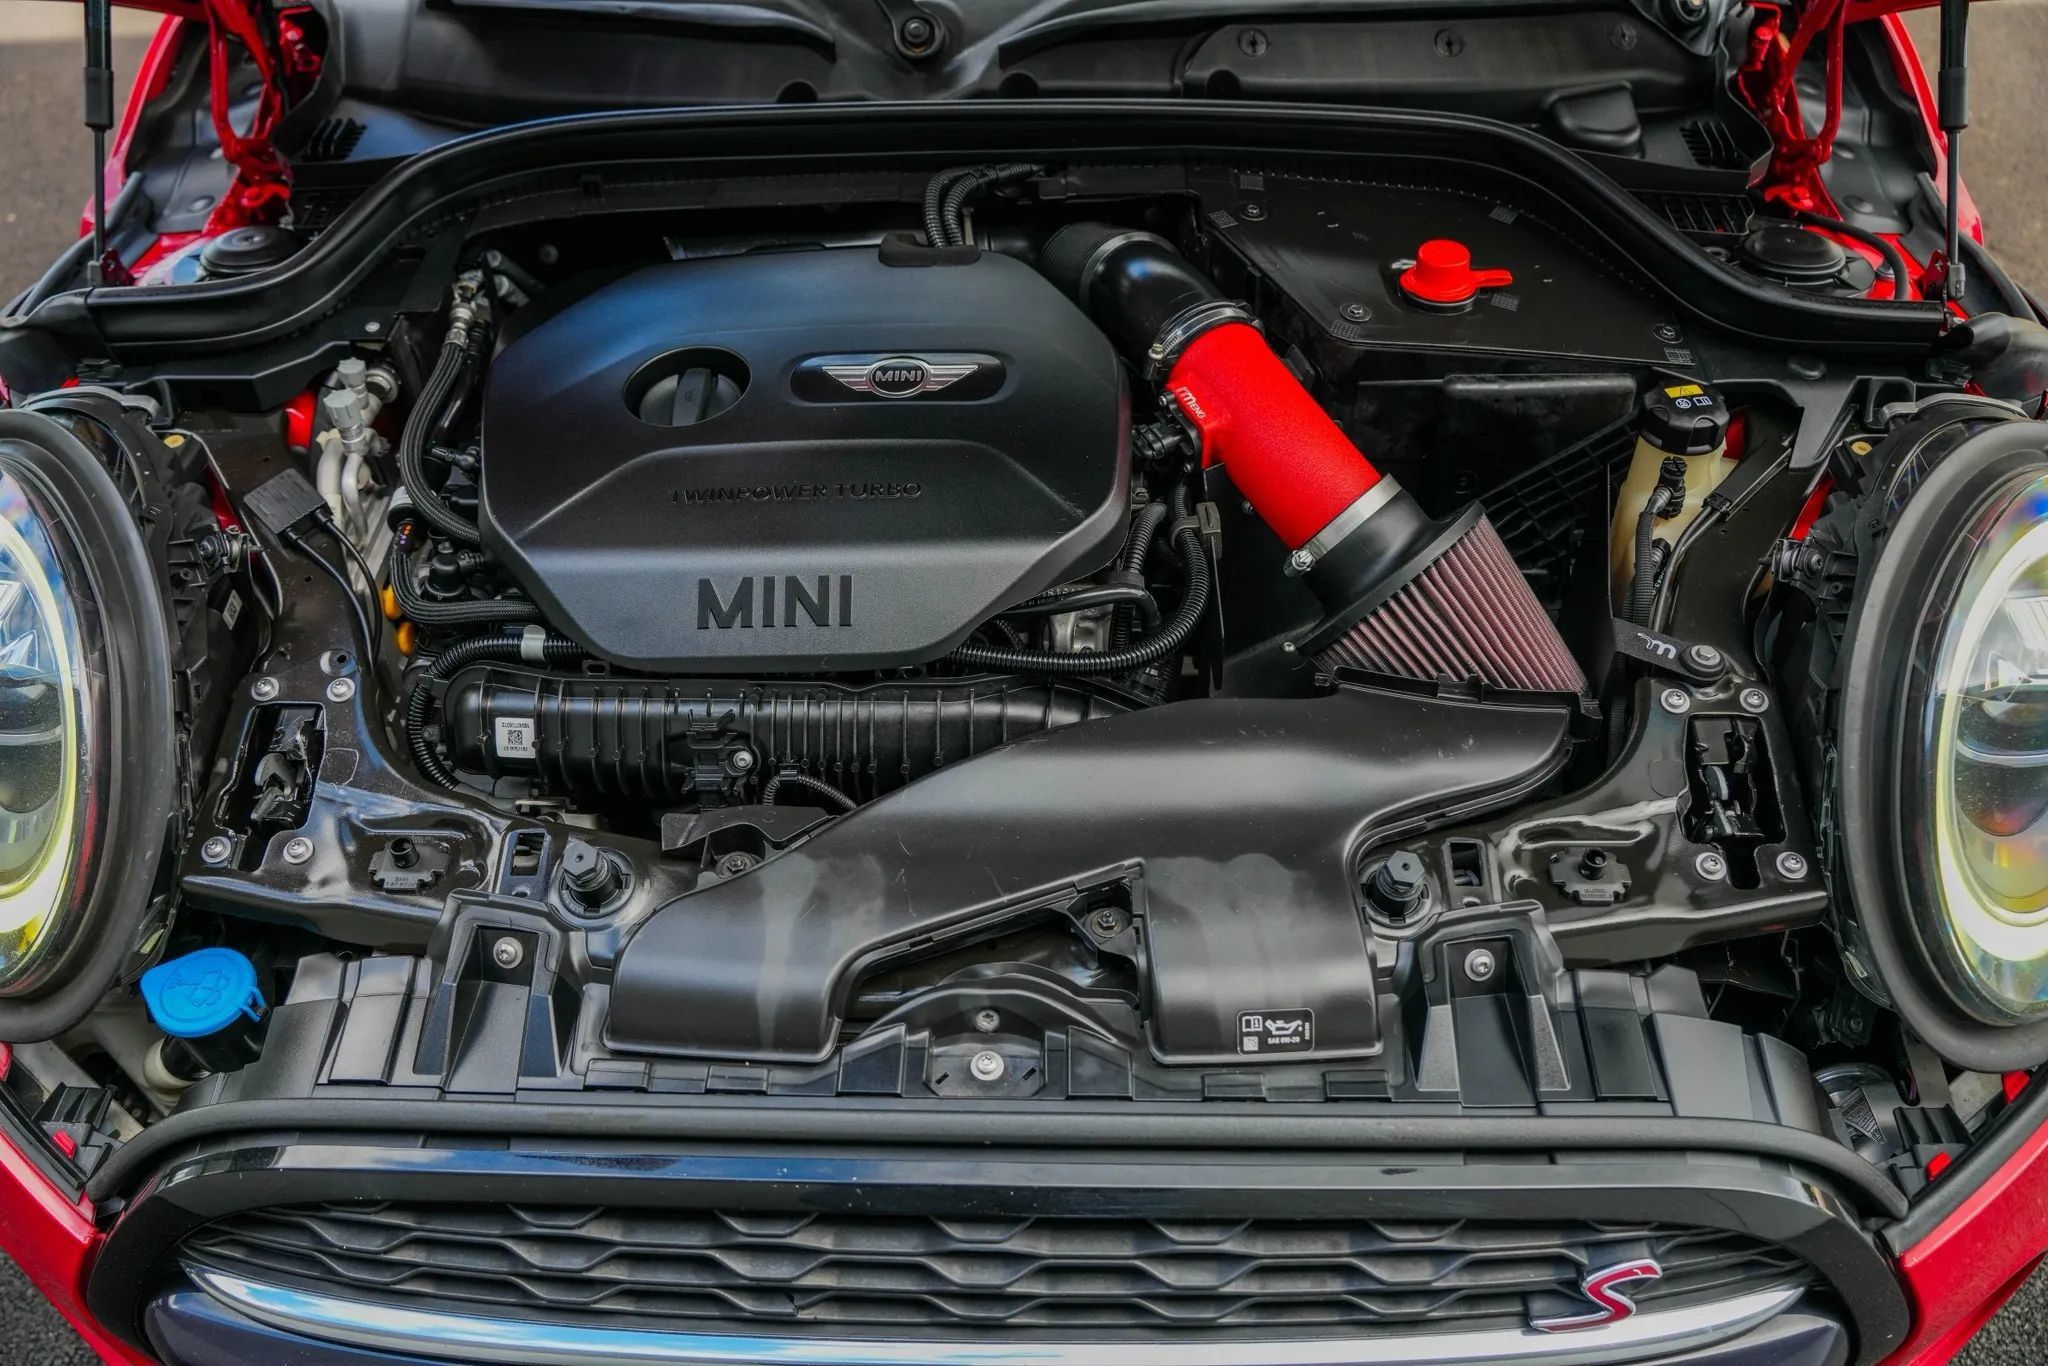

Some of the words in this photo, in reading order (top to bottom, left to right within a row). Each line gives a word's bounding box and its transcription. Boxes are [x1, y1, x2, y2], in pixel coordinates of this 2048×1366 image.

[875, 370, 922, 382] MINI
[669, 482, 828, 505] TWINPOWER
[835, 480, 921, 500] TURBO
[697, 575, 852, 629] MINI
[1529, 1258, 1662, 1333] S
